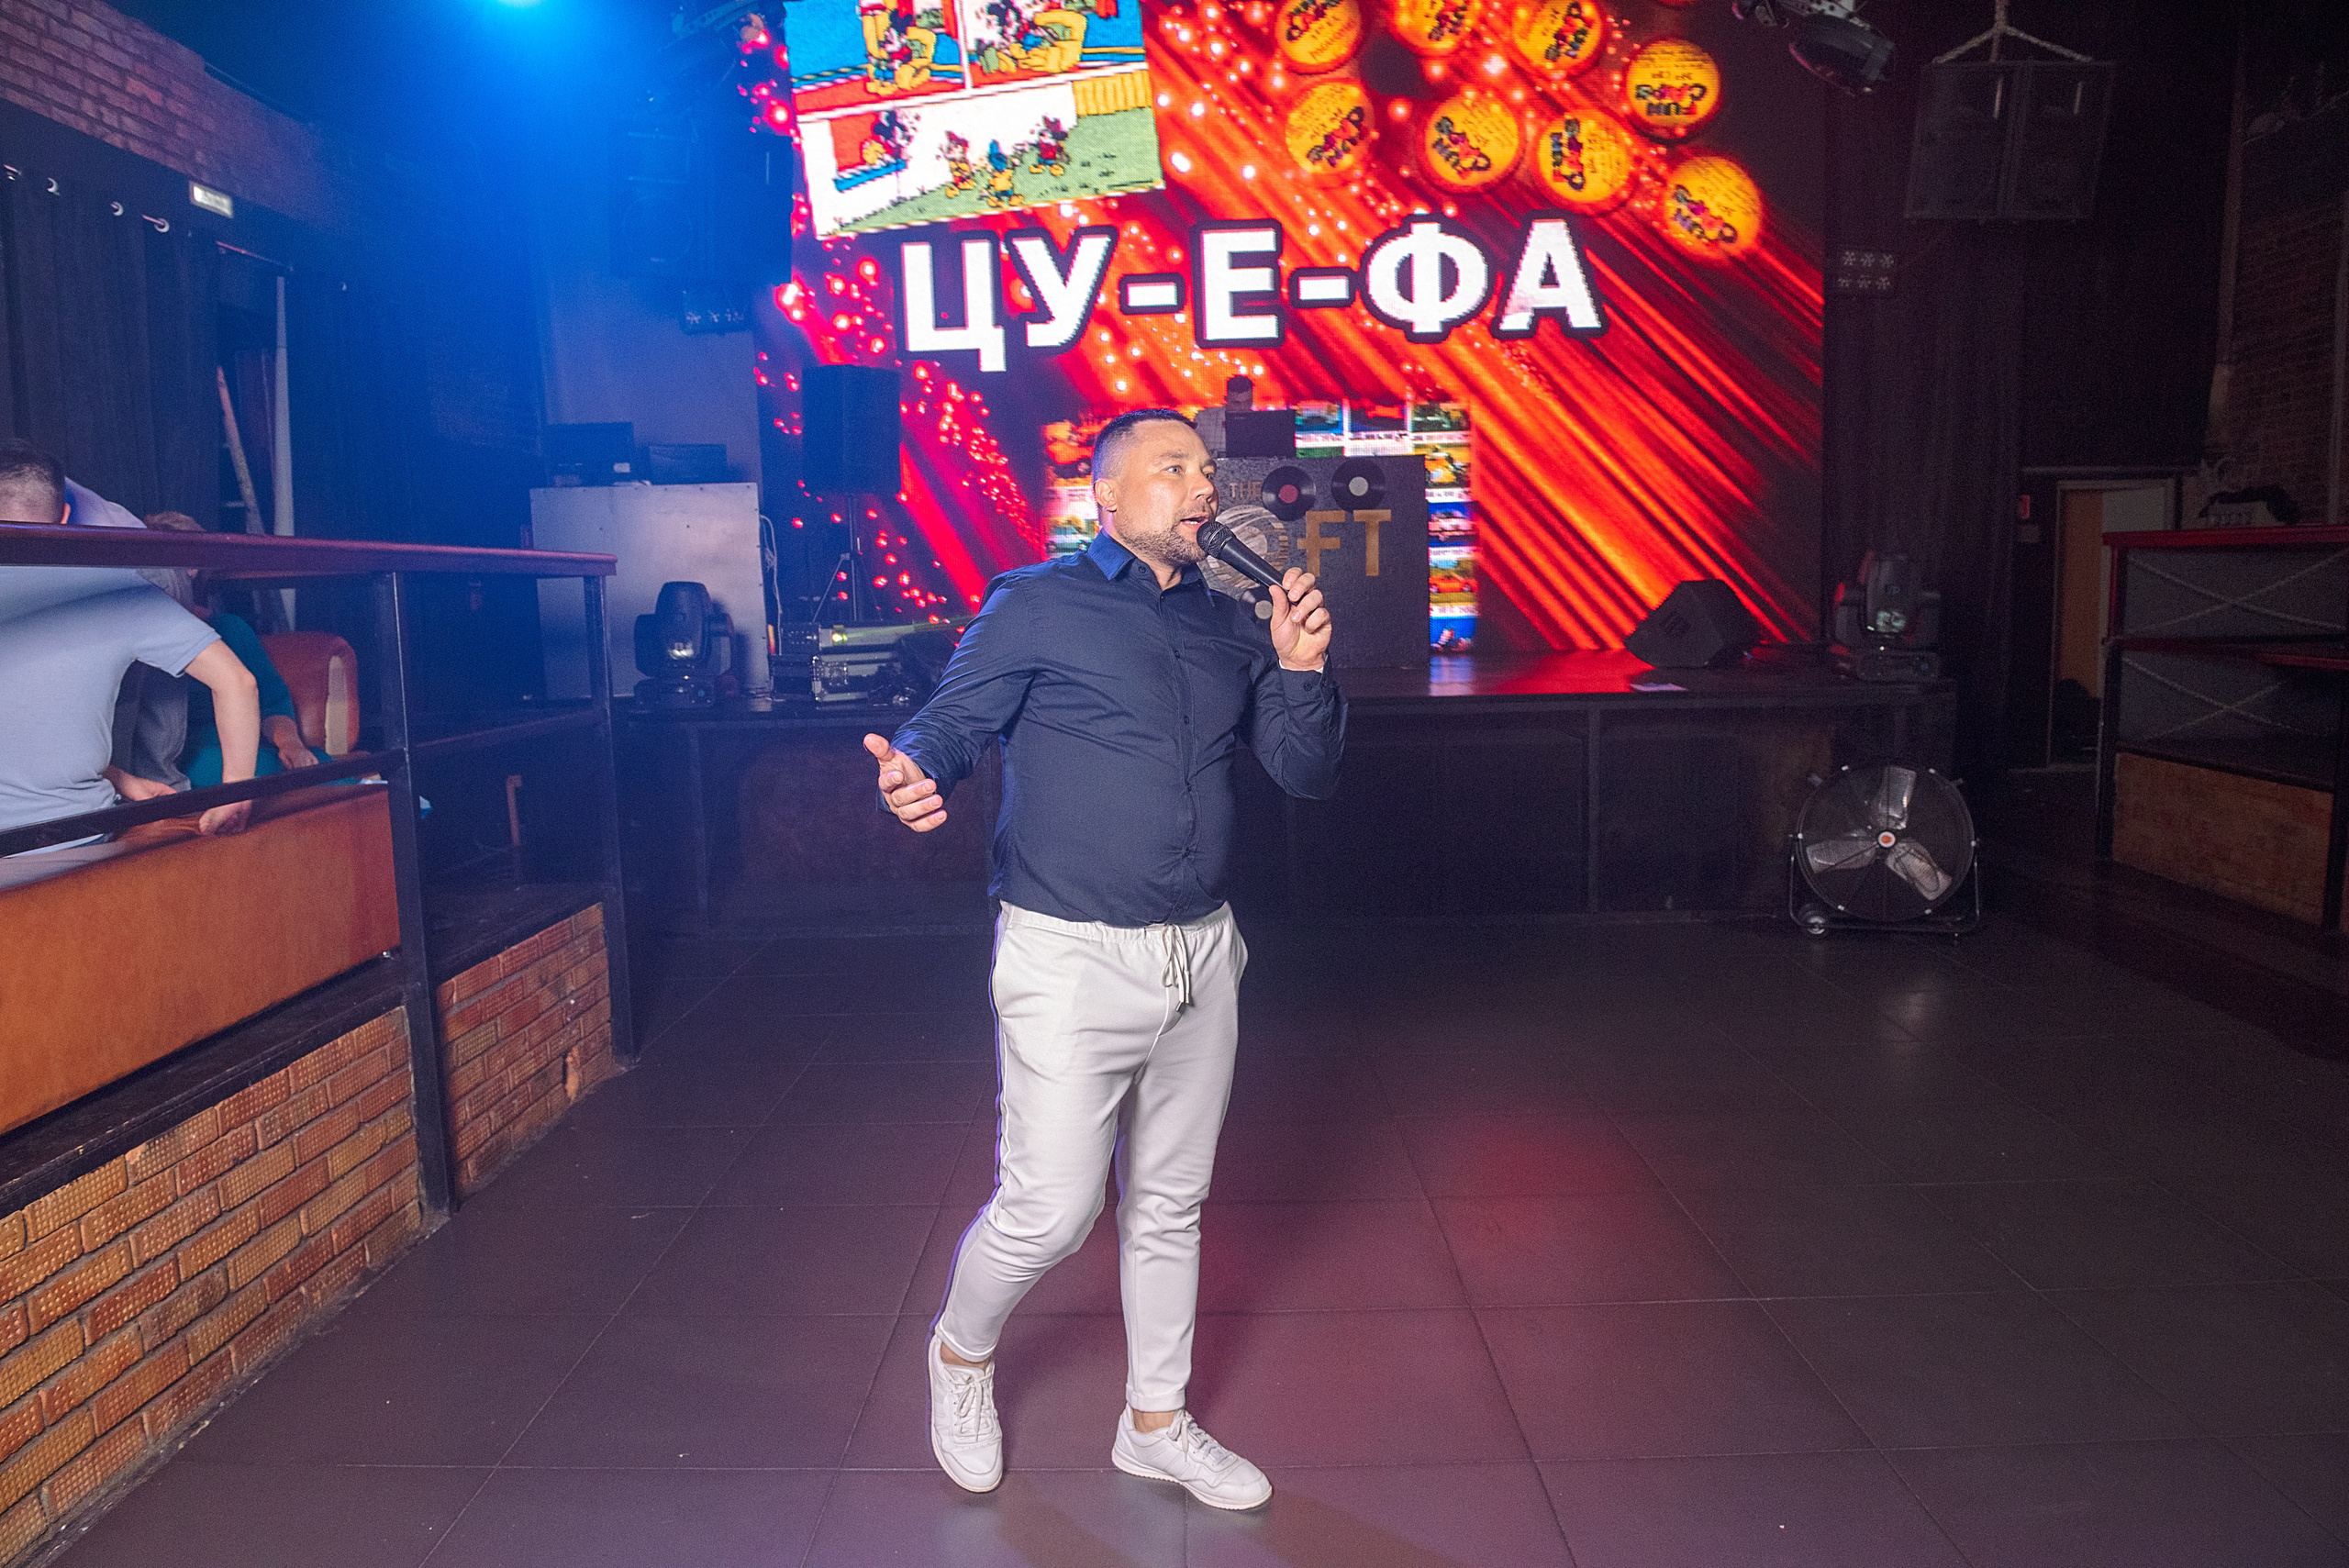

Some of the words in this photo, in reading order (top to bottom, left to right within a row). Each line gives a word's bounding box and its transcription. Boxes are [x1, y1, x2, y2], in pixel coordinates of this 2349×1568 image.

[1635, 83, 1707, 101] CAPS
[1646, 102, 1697, 116] FUN
[900, 219, 1602, 372] ЦУ-Е-ФА
